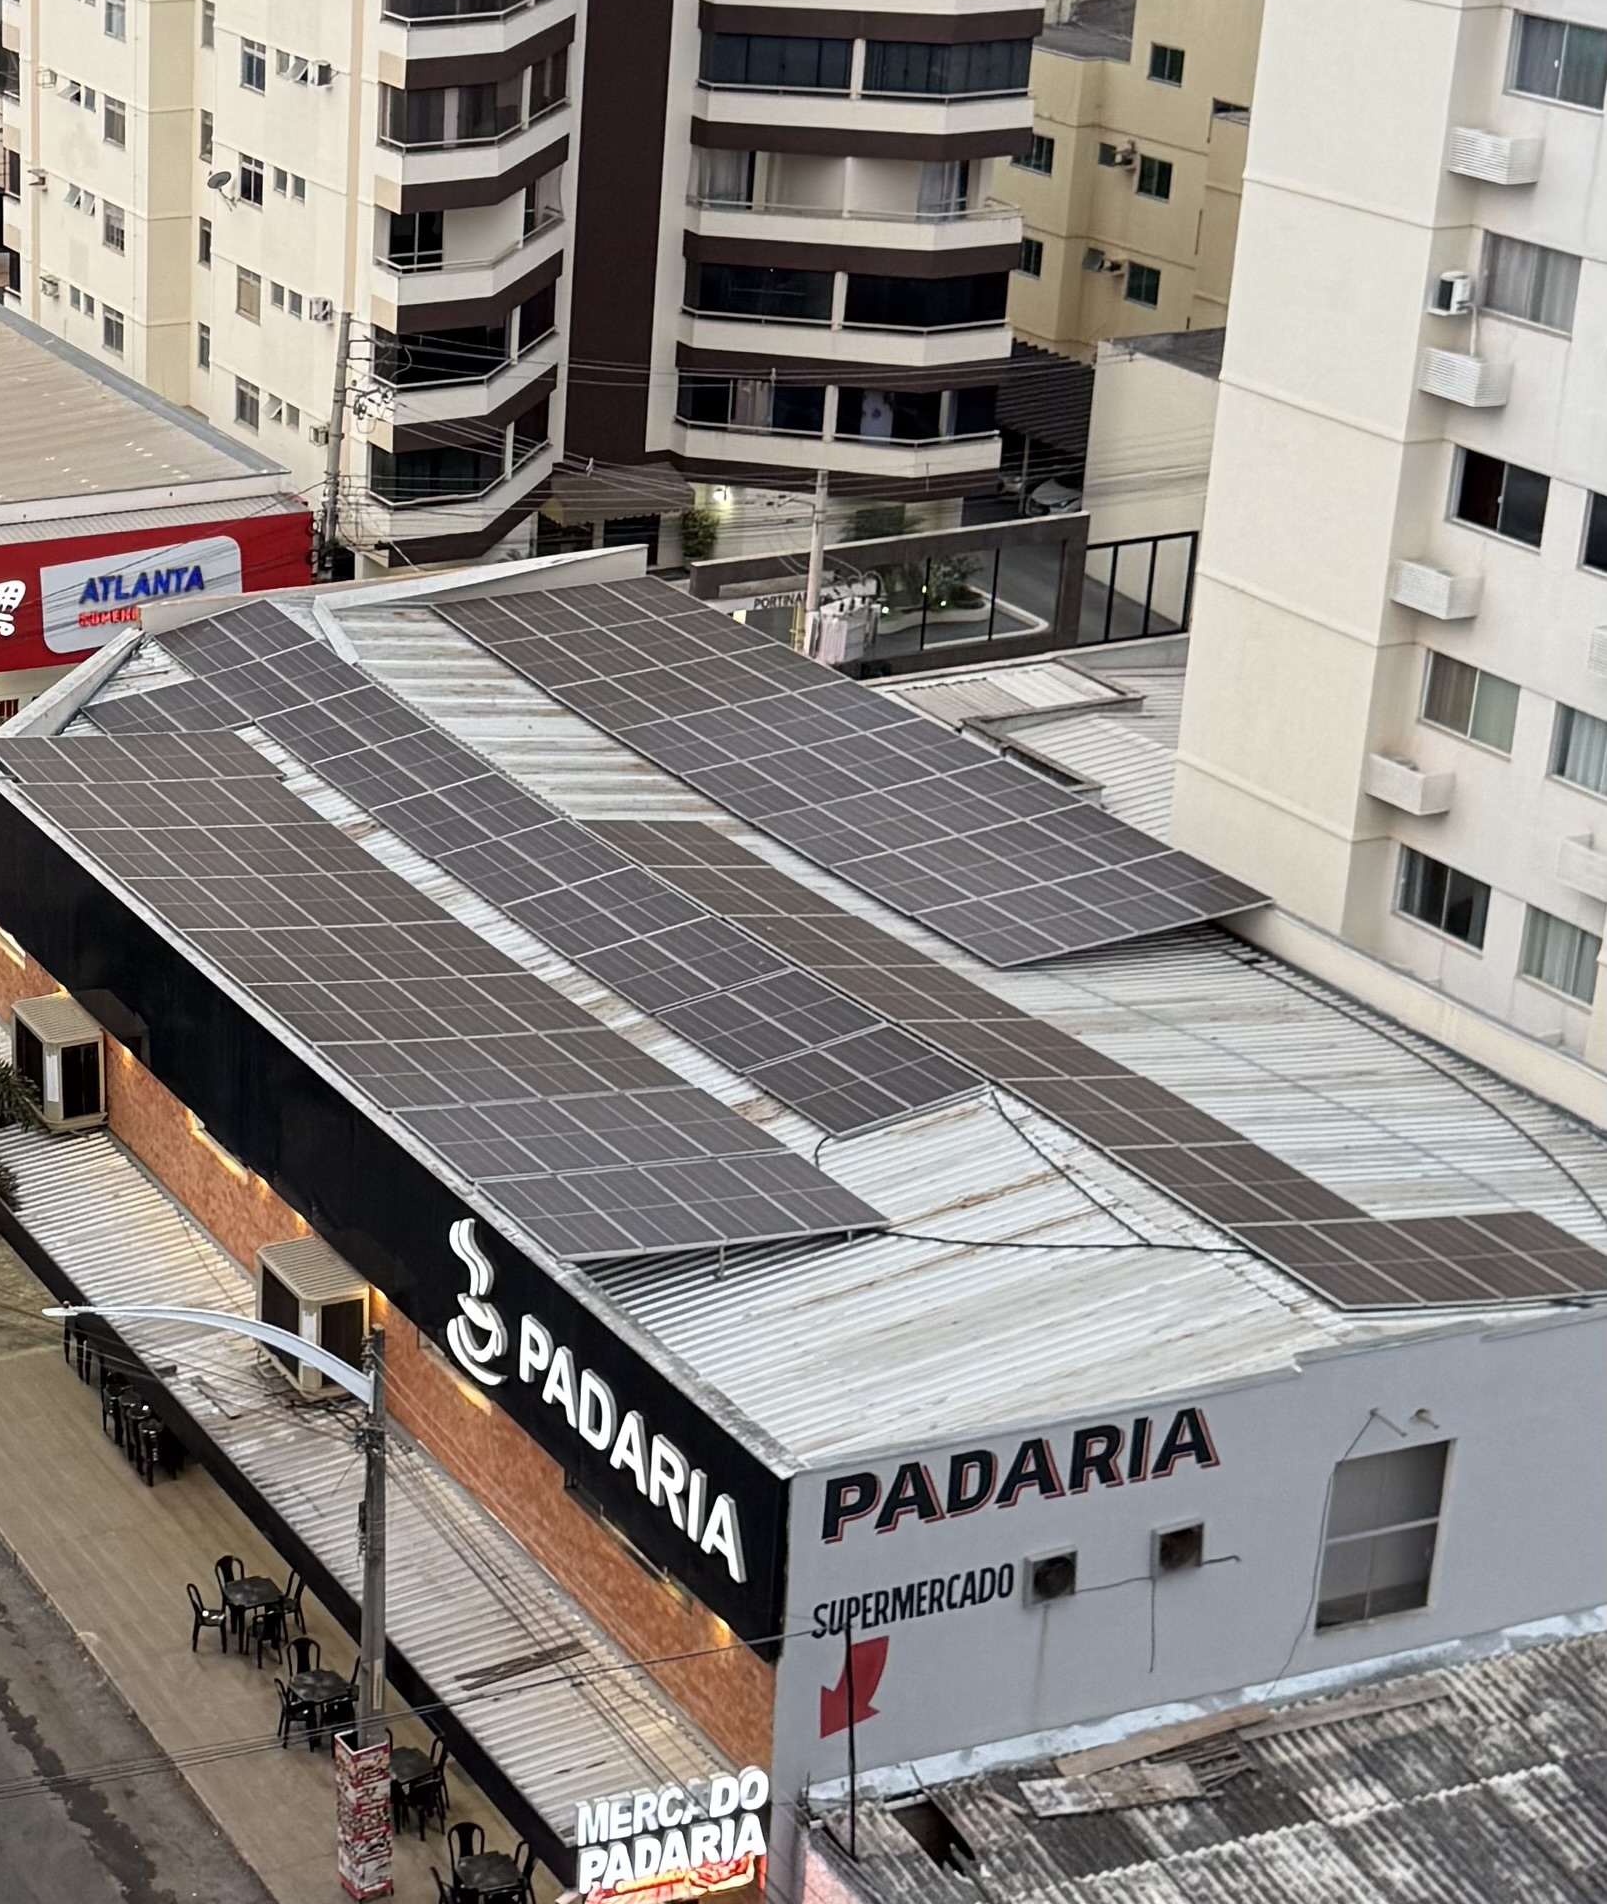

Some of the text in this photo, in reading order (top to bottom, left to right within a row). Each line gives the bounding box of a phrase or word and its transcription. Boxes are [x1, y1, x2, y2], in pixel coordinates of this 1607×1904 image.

[78, 565, 205, 604] ATLANTA
[754, 592, 808, 609] PORTINA
[519, 1314, 747, 1584] PADARIA
[821, 1407, 1221, 1544] PADARIA
[811, 1563, 1014, 1638] SUPERMERCADO
[578, 1813, 767, 1894] PADARIA
